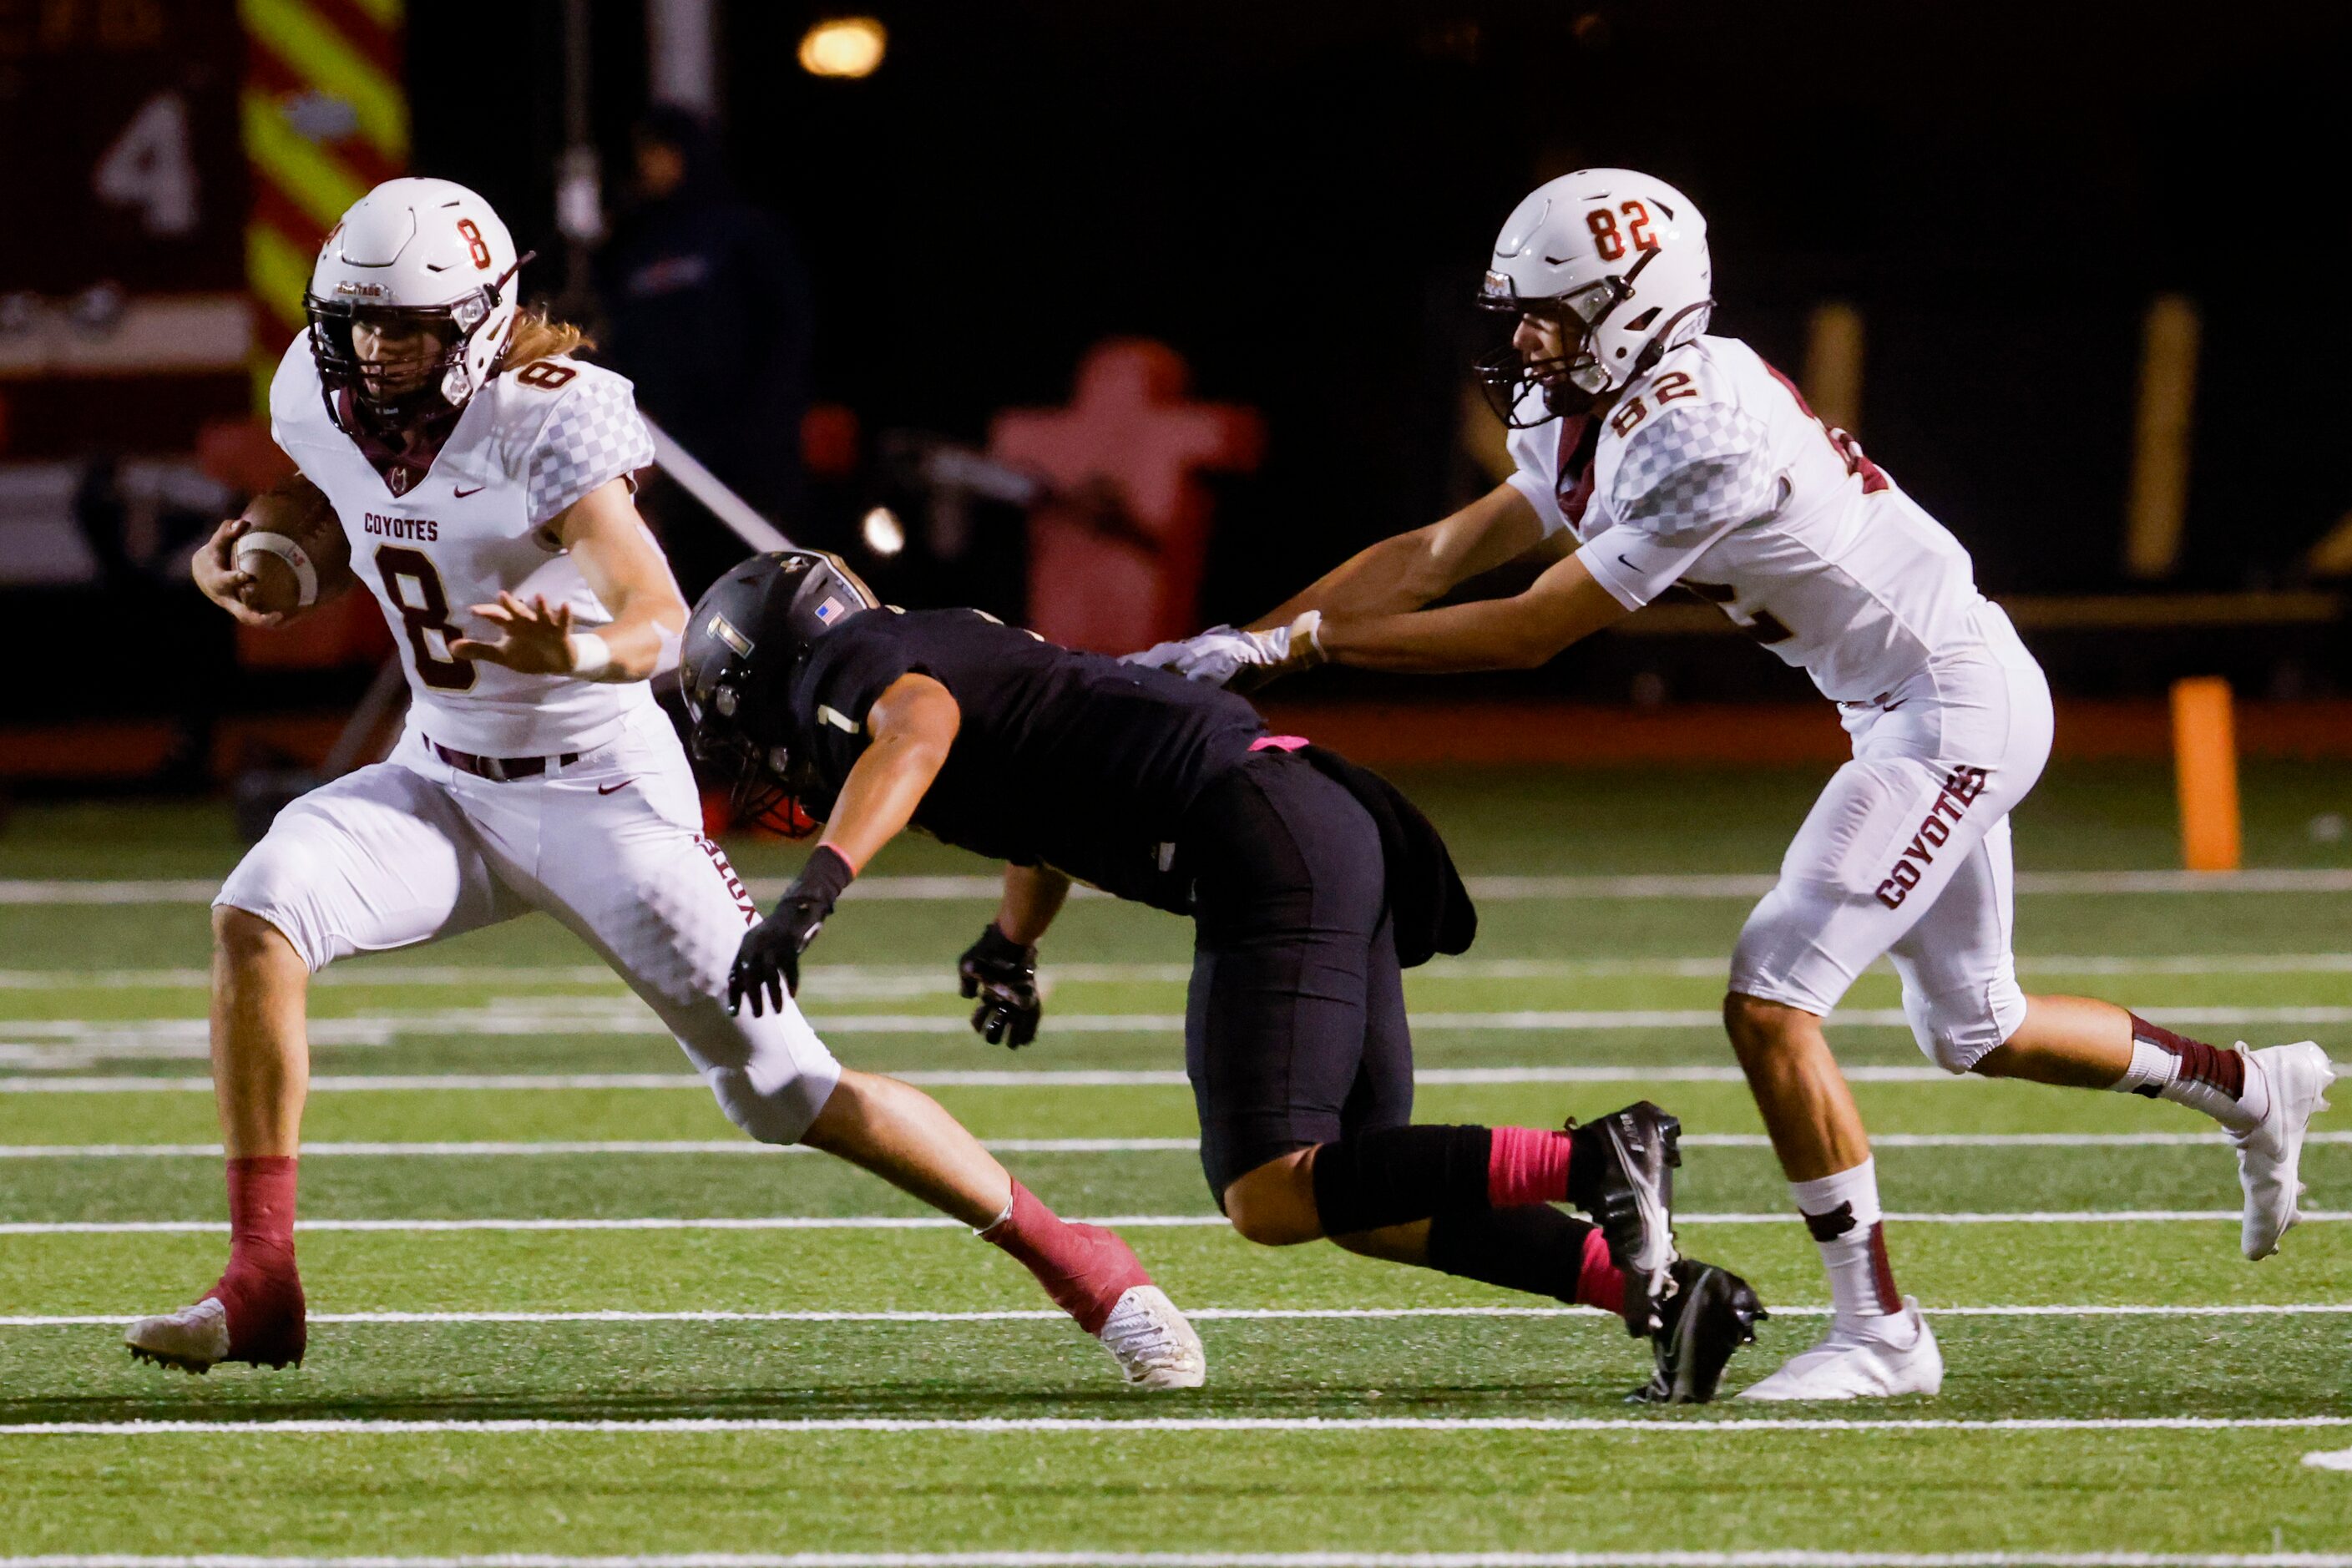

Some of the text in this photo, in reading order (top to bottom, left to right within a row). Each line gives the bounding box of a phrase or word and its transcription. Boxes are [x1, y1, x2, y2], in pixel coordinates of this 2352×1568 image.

[95, 94, 197, 235] 4
[457, 219, 492, 271] 8
[1586, 200, 1658, 261] 82
[516, 360, 579, 391] 8
[1611, 372, 1697, 439] 82
[364, 513, 438, 542] COYOTES
[373, 544, 480, 693] 8
[1875, 765, 1987, 910] COYOTES
